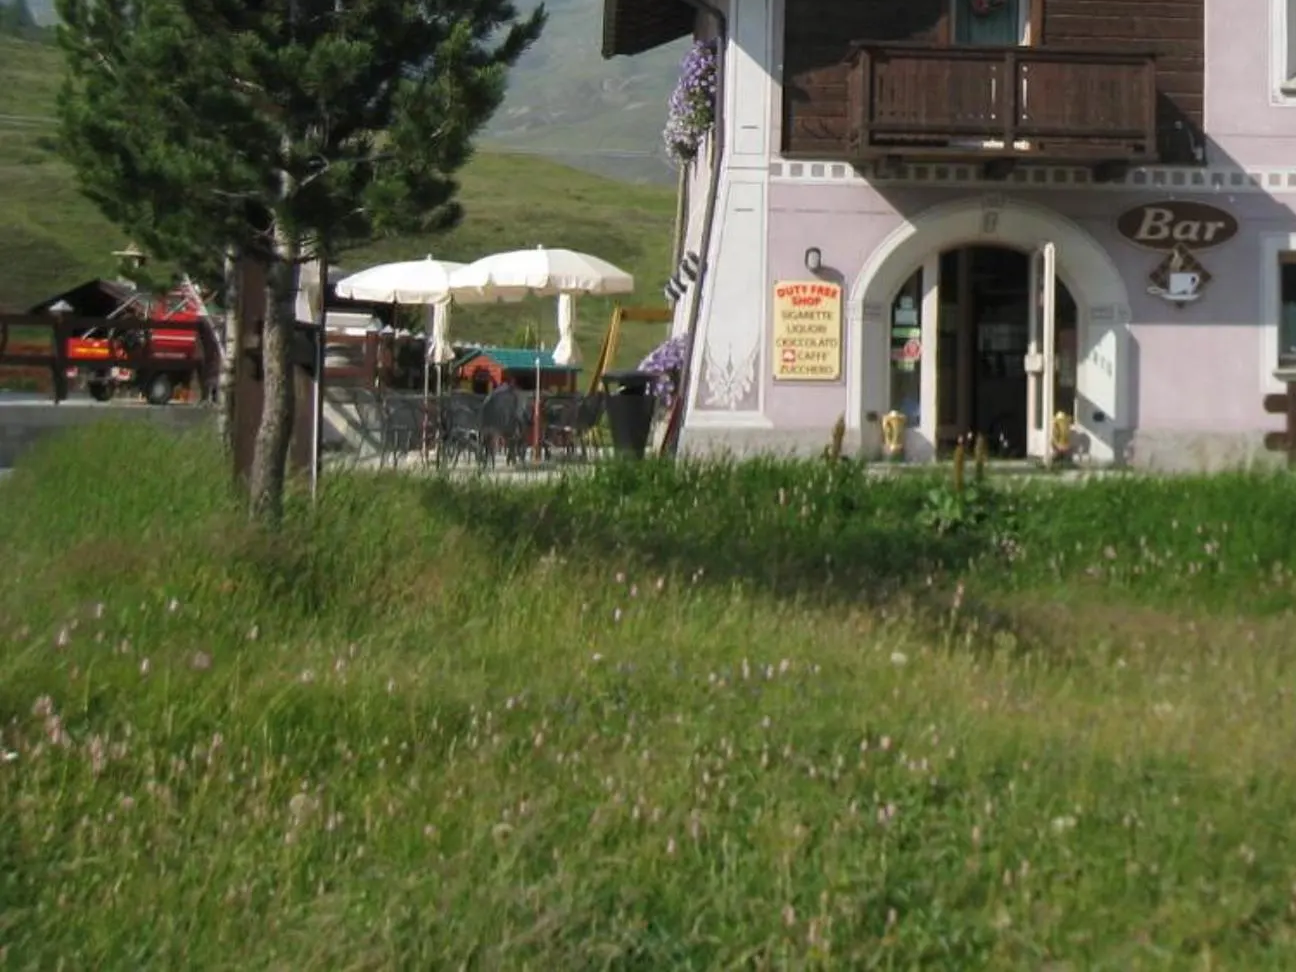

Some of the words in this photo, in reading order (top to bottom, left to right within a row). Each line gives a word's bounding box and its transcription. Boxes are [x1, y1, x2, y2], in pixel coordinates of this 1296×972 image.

[1135, 207, 1225, 241] Bar
[777, 285, 807, 298] DUTY
[811, 285, 838, 298] FREE
[792, 296, 822, 306] SHOP
[781, 310, 832, 321] SIGARETTE
[787, 324, 827, 334] LIQUORI
